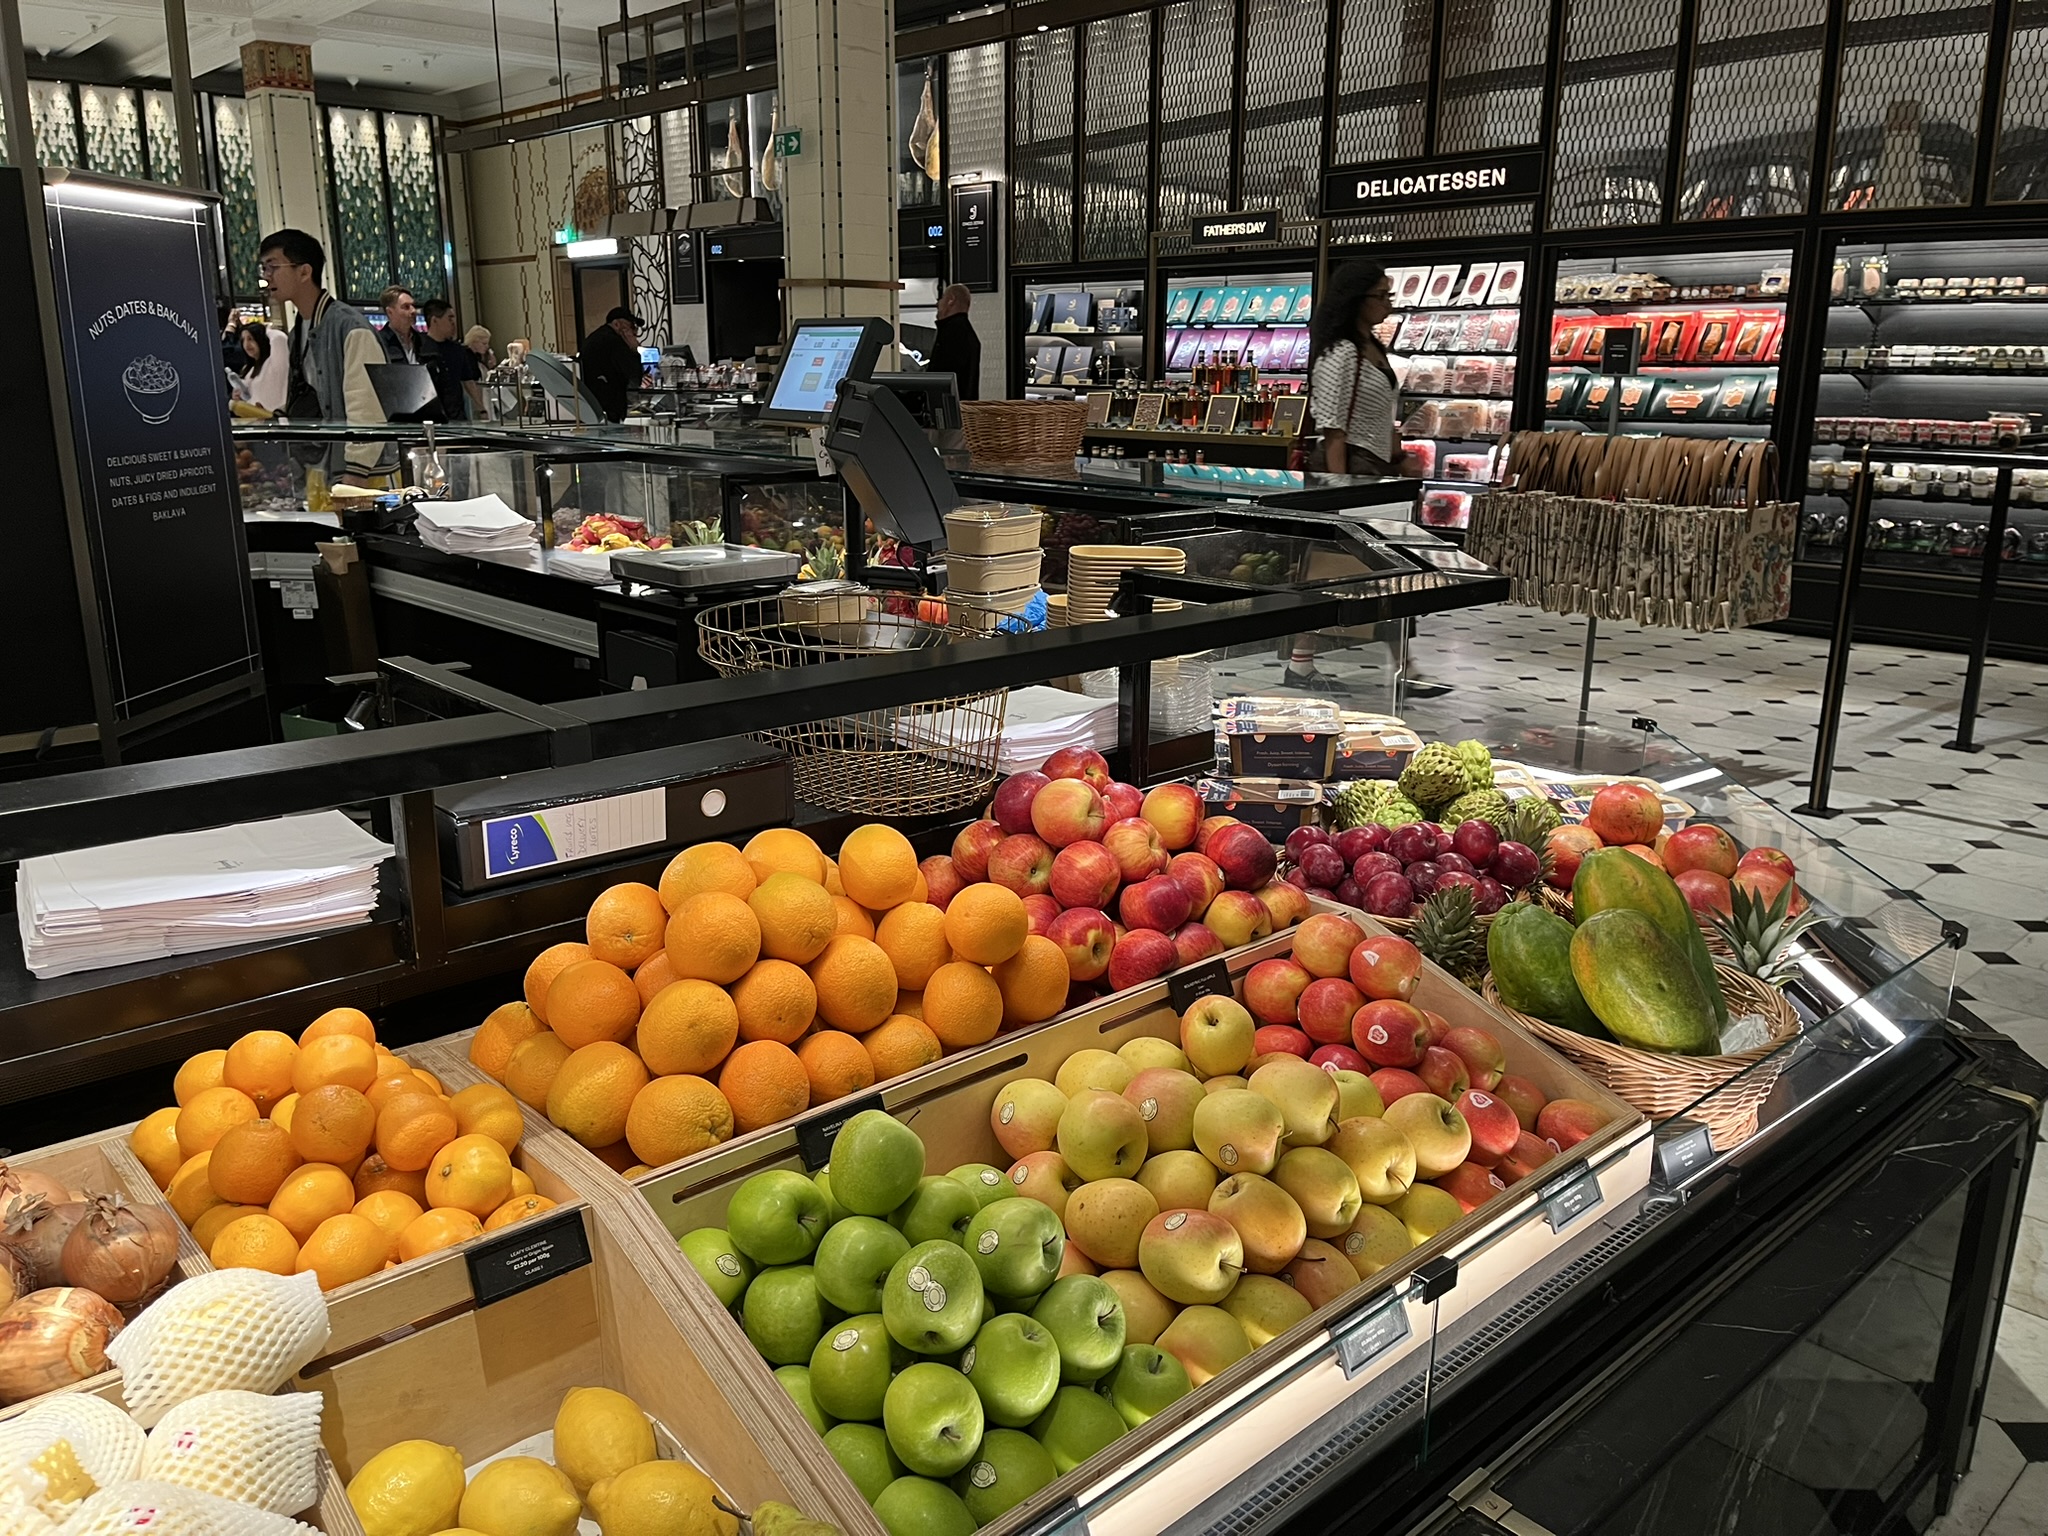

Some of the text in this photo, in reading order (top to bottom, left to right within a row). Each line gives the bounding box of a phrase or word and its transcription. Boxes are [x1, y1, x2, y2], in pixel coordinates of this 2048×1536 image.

[1356, 168, 1506, 199] DELICATESSEN
[928, 226, 943, 237] 002
[1203, 221, 1267, 237] FATHER'S DAY
[89, 300, 198, 344] NUTS, DATES & BAKLAVA
[106, 447, 212, 467] DELICIOUS SWEET & SAVOURY
[109, 465, 214, 487] NUTS, JUICY DRIED APRICOTS,
[111, 483, 216, 508] DATES & FIGS AND INDULGENT
[152, 507, 186, 521] BAKLAVA
[510, 827, 520, 860] Lyreco
